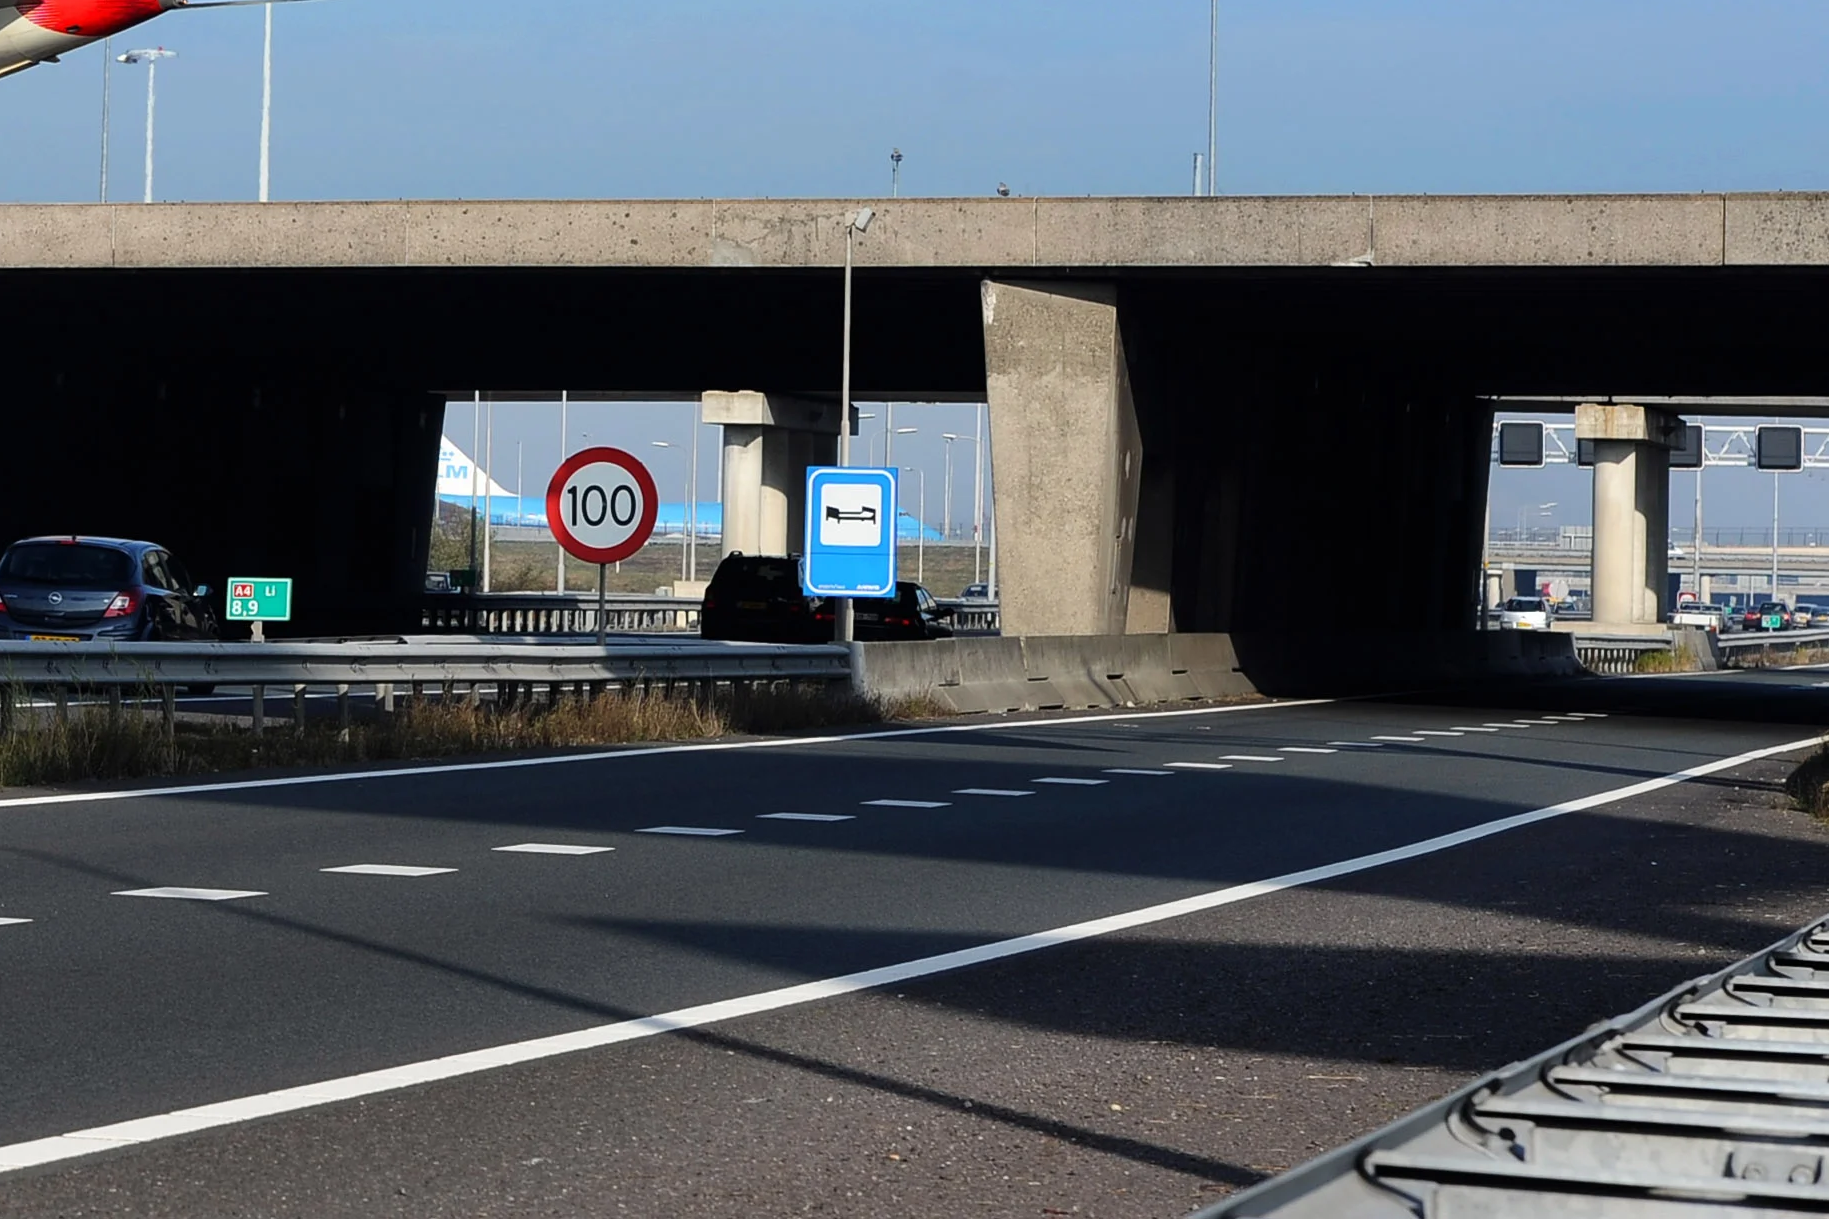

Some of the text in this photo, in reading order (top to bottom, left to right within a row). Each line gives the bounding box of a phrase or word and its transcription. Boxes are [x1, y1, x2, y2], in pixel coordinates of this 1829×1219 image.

[566, 483, 638, 528] 100
[234, 585, 252, 597] A4
[231, 600, 259, 617] 8,9
